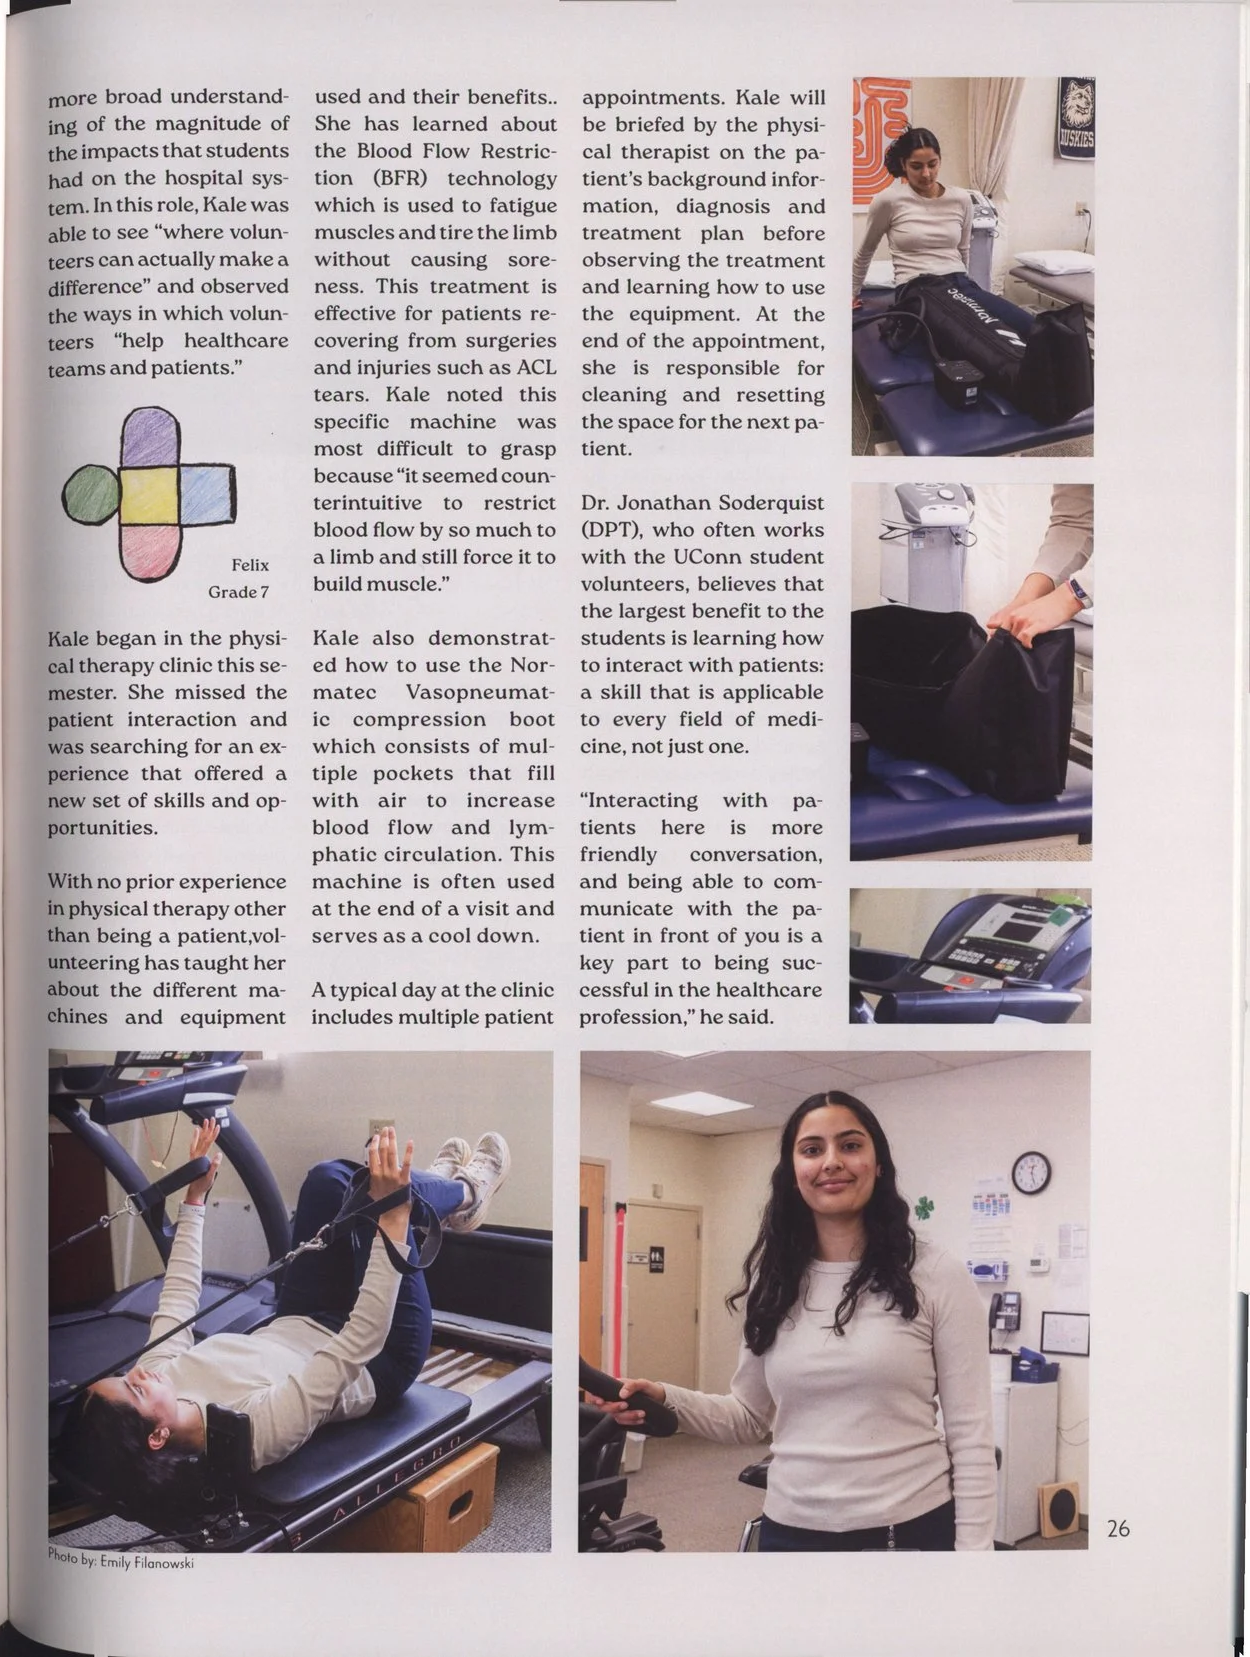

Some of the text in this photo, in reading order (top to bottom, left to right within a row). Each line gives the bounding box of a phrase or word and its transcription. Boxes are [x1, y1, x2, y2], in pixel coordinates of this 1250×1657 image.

[49, 88, 289, 108] more broad understand-
[316, 88, 557, 105] used and their benefits..
[583, 89, 825, 109] appointments. Kale will
[1061, 129, 1094, 147] HUSKIES
[315, 168, 557, 190] tion (BFR) technology
[583, 198, 825, 218] mation, diagnosis and
[157, 278, 194, 293] and
[201, 278, 289, 293] observed
[48, 364, 106, 378] teams
[110, 359, 147, 375] and
[314, 359, 557, 379] and injuries such as ACL
[582, 494, 825, 514] Dr. Jonathan Soderquist
[582, 520, 824, 540] (DPT), who often works
[232, 559, 269, 571] Felix
[209, 586, 269, 598] Grade 7
[314, 576, 362, 591] build
[49, 684, 287, 700] mester. She missed the
[313, 684, 555, 703] matec Vasopneumat-
[48, 820, 157, 839] portunities.
[581, 846, 822, 866] friendly conversation,
[312, 1009, 554, 1028] includes multiple patient
[700, 1009, 723, 1024] he
[728, 1009, 773, 1024] said.
[333, 1436, 461, 1521] ALLEGRO
[1108, 1520, 1130, 1537] 26
[48, 1547, 193, 1571] Photo by: Emily Filanowski
